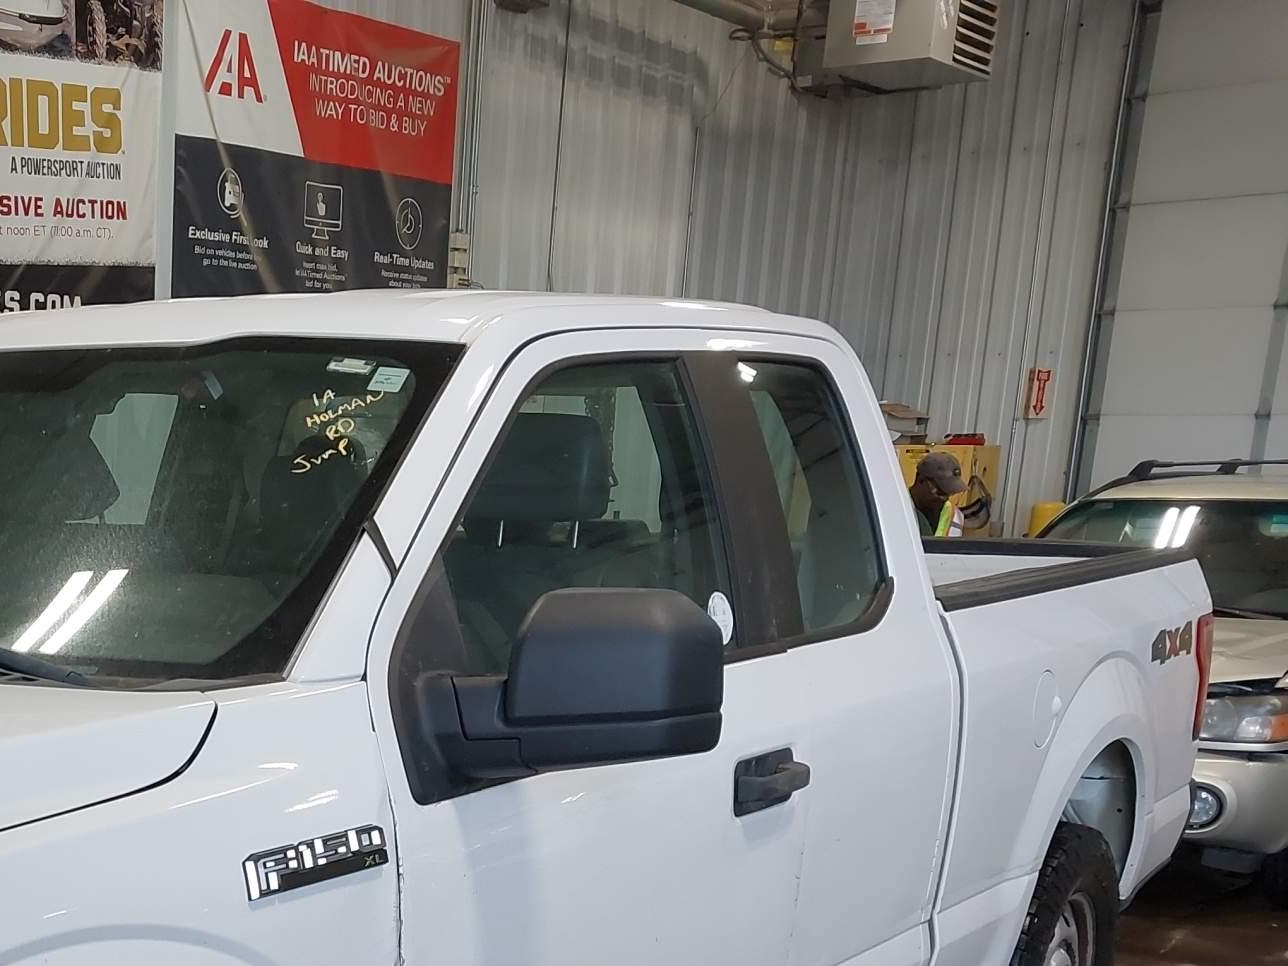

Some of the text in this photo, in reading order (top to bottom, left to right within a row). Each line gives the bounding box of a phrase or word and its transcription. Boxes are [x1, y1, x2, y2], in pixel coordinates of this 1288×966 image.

[294, 40, 317, 66] IAA
[320, 48, 370, 78] TIMED
[309, 72, 435, 116] INTRODUCING A NEW
[316, 99, 427, 136] WAY TO BID & BUY
[10, 155, 122, 181] A POWERSPORT AUCTION
[53, 197, 128, 221] AUCTION
[6, 227, 31, 236] noon
[33, 225, 47, 237] ET
[188, 226, 230, 242] Exclusive
[252, 237, 269, 248] ook
[236, 250, 254, 260] befor
[296, 241, 348, 261] Quick and Easy
[374, 251, 434, 269] Real-Time Updates
[364, 854, 385, 867] XL
